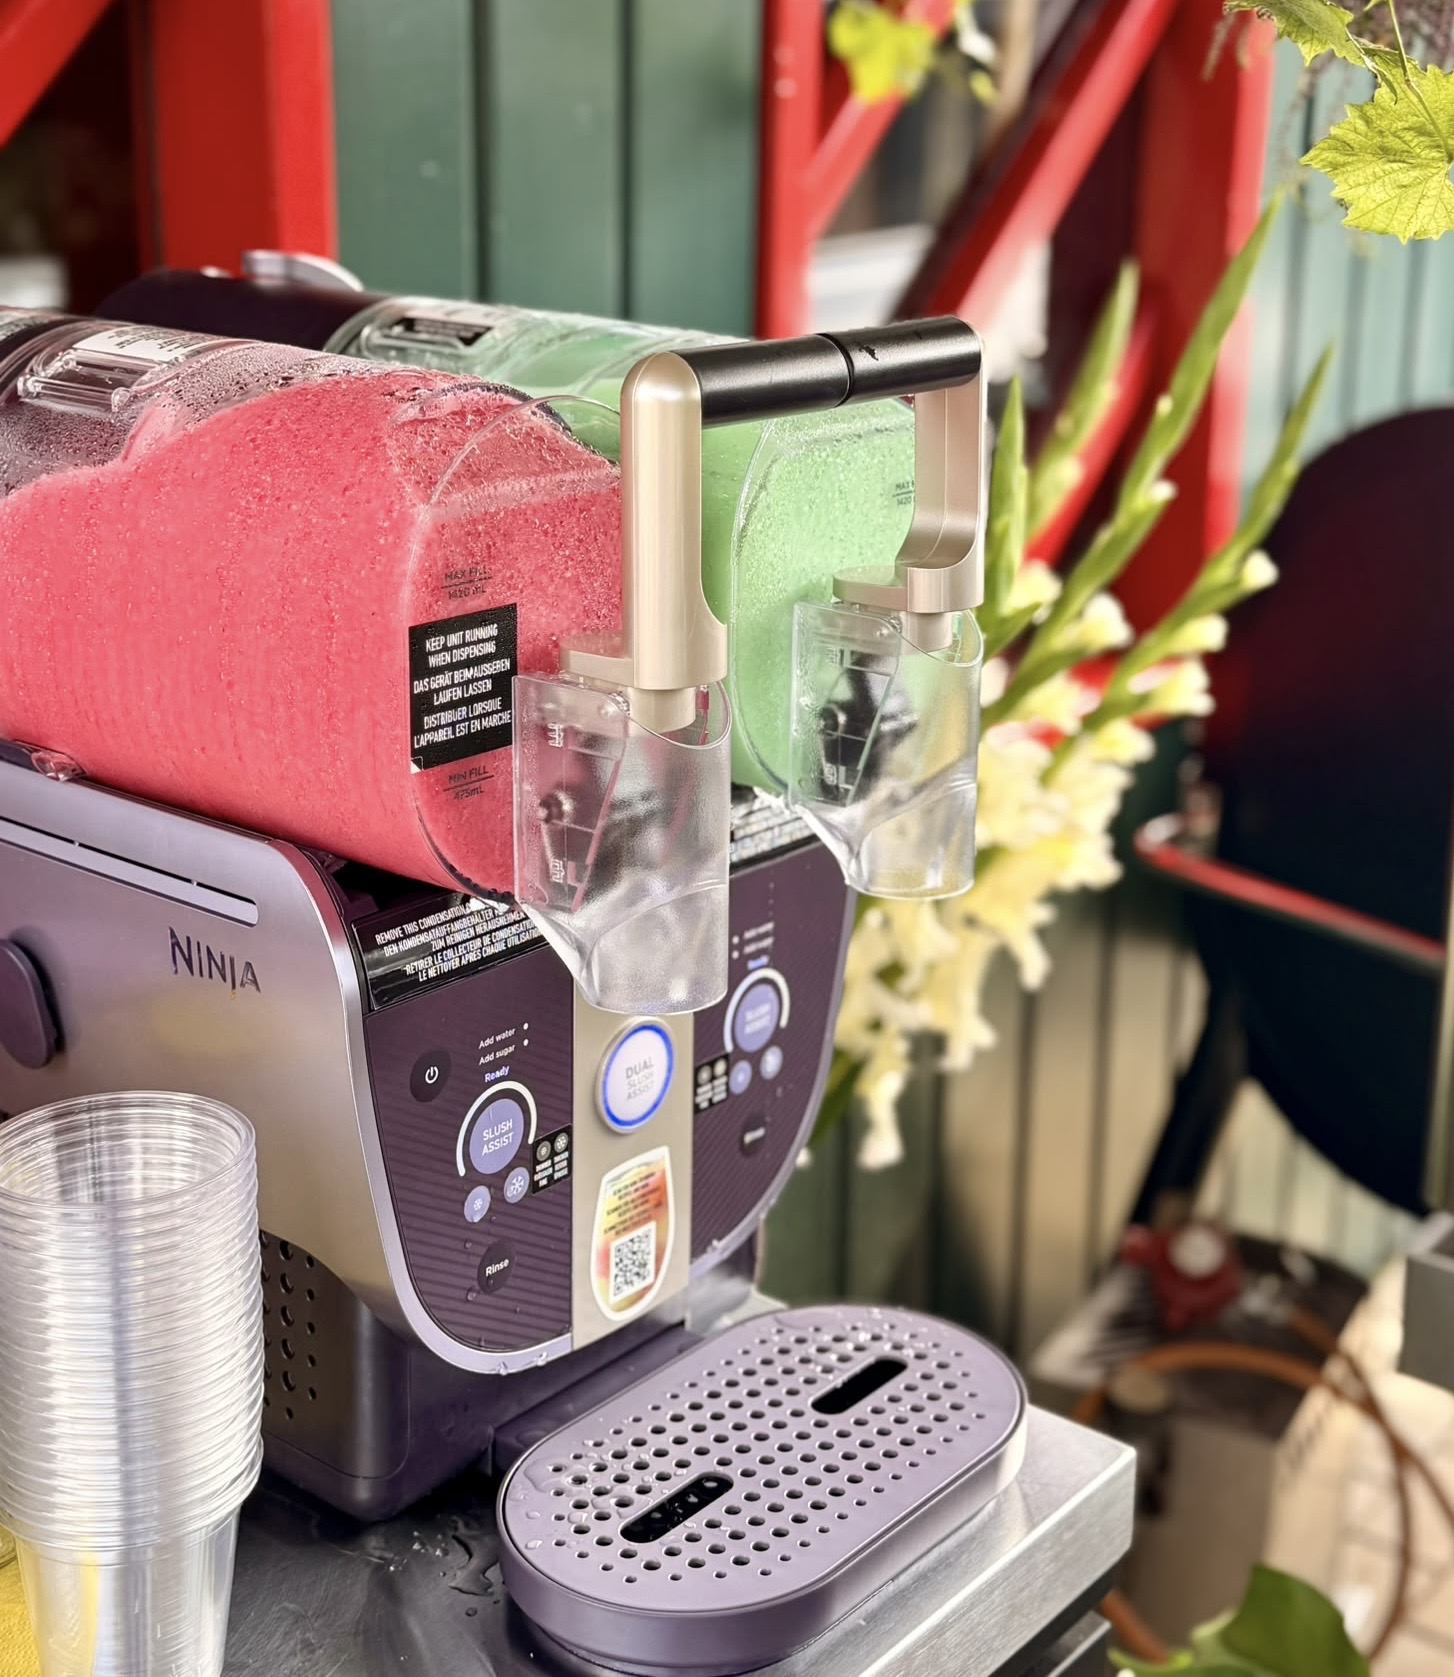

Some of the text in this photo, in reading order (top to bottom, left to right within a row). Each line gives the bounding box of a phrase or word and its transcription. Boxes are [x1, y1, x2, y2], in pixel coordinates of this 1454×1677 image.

[425, 623, 498, 652] KEEP UNIT RUNNING
[428, 641, 496, 668] WHEN DISPENSING
[413, 678, 429, 694] DAS
[430, 671, 453, 689] GERÄT
[433, 678, 492, 706] LAUFEN LASSEN
[424, 697, 502, 730] DISTRIBUER LORSQUE
[414, 710, 512, 749] L'APPAREIL EST EN MARCHE
[469, 765, 489, 778] FILL
[375, 926, 404, 945] REMOVE
[402, 921, 419, 935] THIS
[418, 904, 466, 930] CONDENSATION
[383, 942, 399, 957] DEN
[430, 938, 446, 952] ZUM
[445, 928, 475, 947] REINIGEN
[169, 926, 261, 998] NINJA
[405, 956, 433, 976] RETIRER
[433, 952, 443, 964] LE
[442, 938, 482, 961] COLLECTEUR
[482, 934, 492, 946] DE
[418, 970, 428, 982] LE
[427, 957, 461, 980] NETTOYER
[482, 939, 506, 957] CHAQUE
[479, 1028, 515, 1049] Add water
[479, 1044, 515, 1065] Add sugar
[484, 1065, 509, 1082] Ready
[626, 1057, 654, 1080] DUAL
[627, 1071, 654, 1091] SLUSH
[627, 1080, 655, 1101] ASSIST
[483, 1118, 512, 1141] SLUSH
[482, 1132, 514, 1156] ASSIST
[485, 1259, 509, 1277] Rinse
